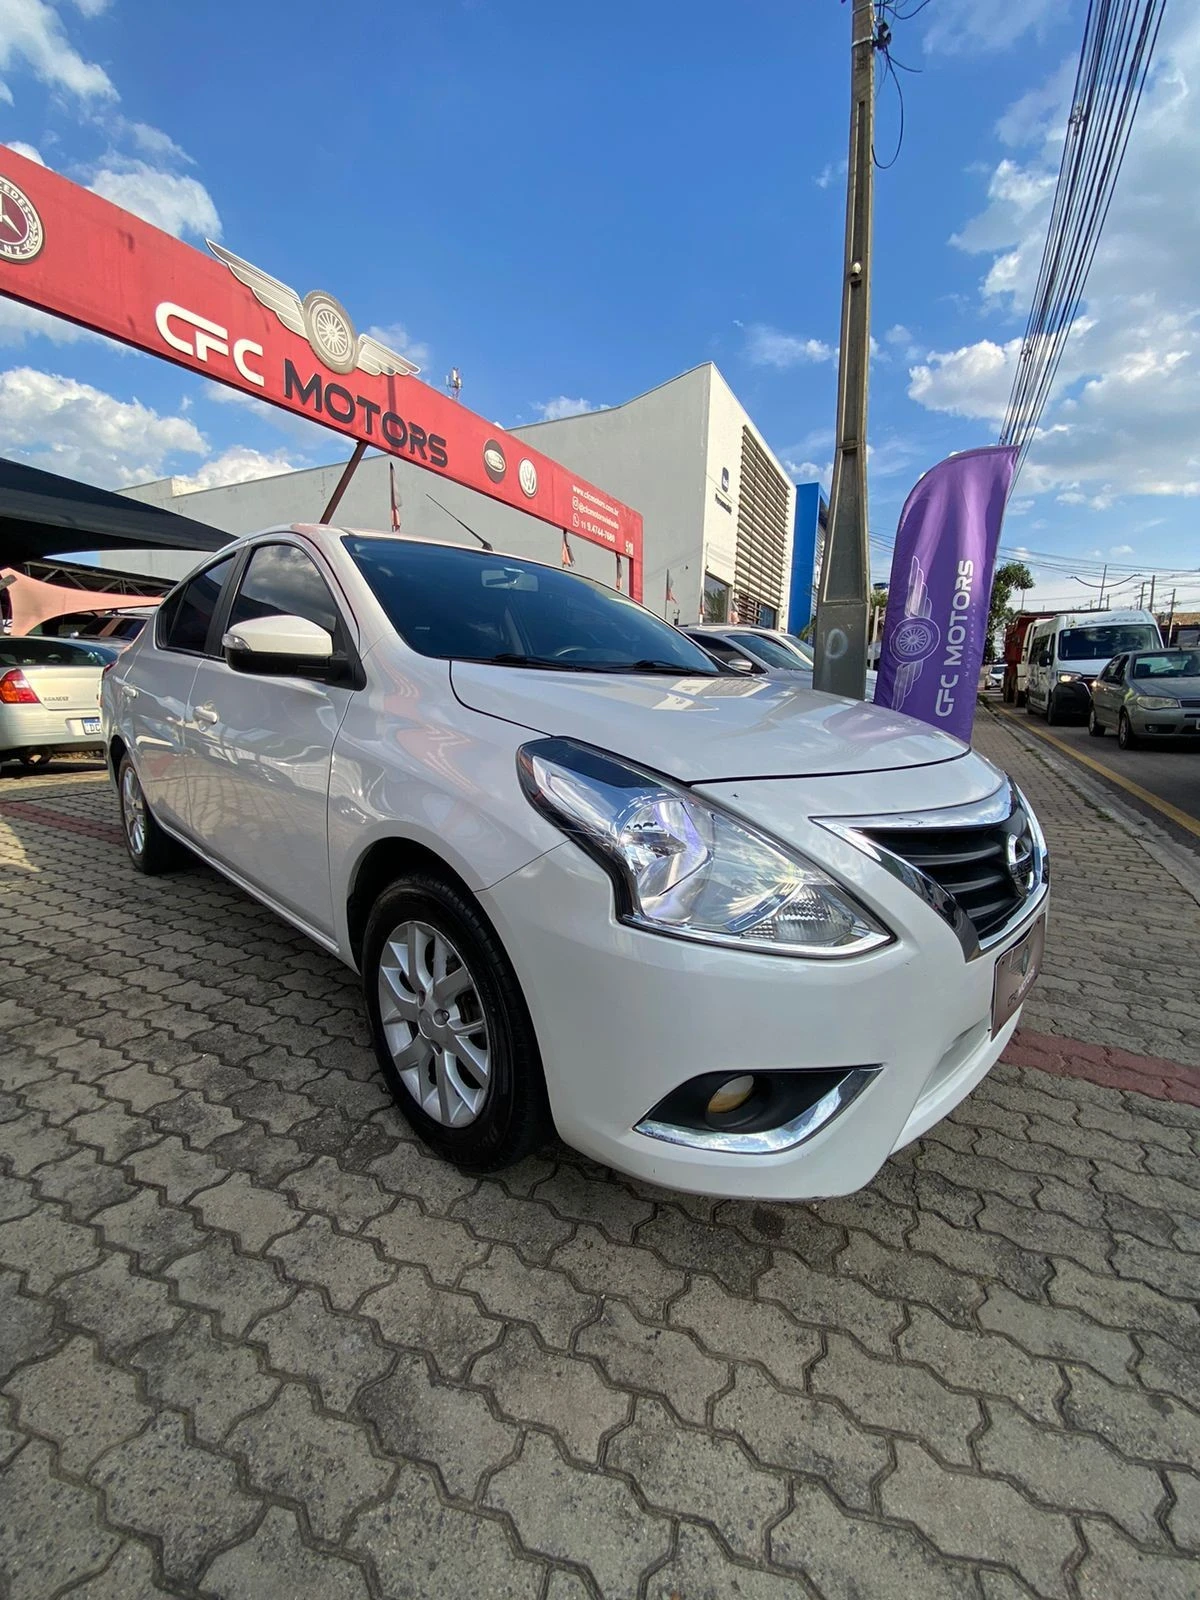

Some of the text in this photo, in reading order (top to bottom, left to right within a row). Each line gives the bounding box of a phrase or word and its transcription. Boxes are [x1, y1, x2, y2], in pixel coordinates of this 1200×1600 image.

[0, 181, 30, 213] EDES
[155, 301, 448, 467] CFC MOTORS
[935, 559, 974, 717] CFC MOTORS
